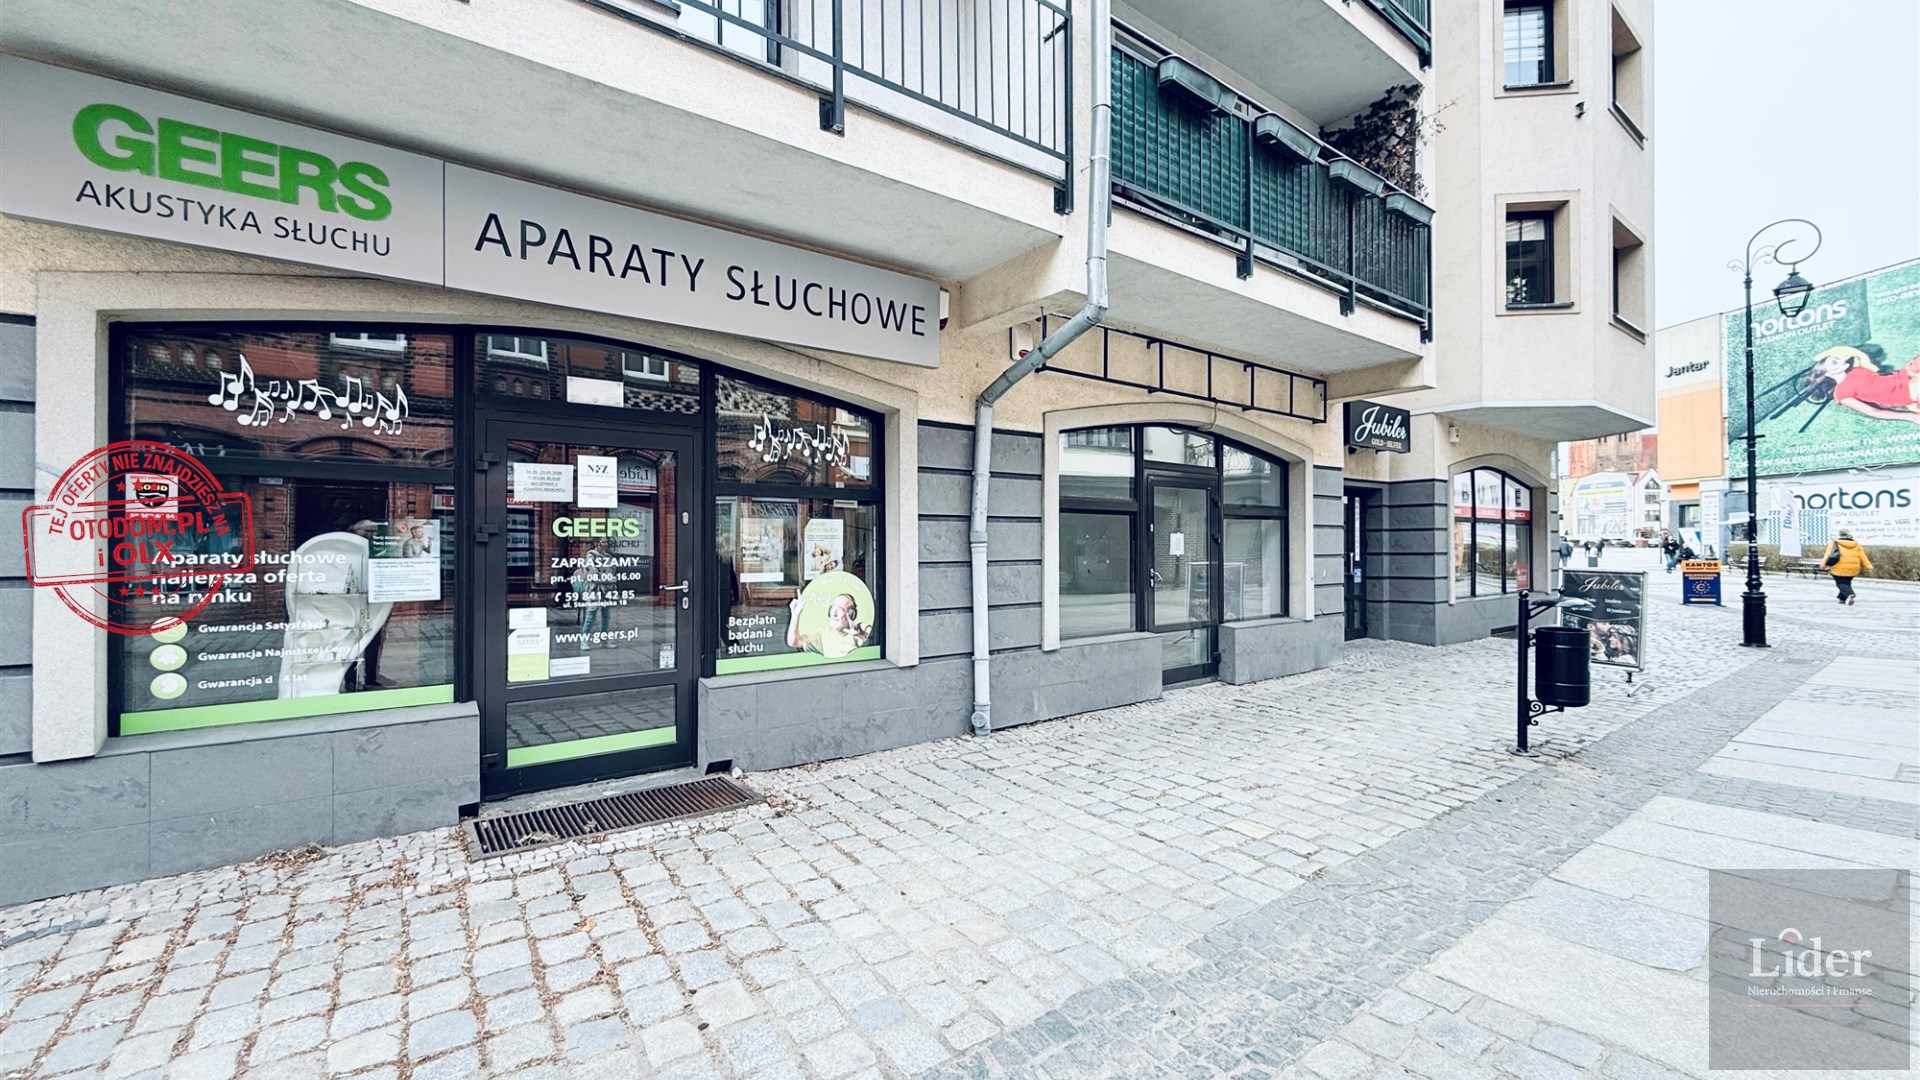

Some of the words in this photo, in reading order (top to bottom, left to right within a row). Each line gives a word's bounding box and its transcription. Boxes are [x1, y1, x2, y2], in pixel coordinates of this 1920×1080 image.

[72, 103, 392, 222] GEERS
[76, 180, 262, 235] AKUSTYKA
[274, 216, 391, 256] SŁUCHU
[475, 213, 704, 293] APARATY
[725, 264, 926, 337] SŁUCHOWE
[1755, 328, 1797, 346] FASHION
[1797, 320, 1836, 335] OUTLET
[1665, 359, 1710, 378] Jantar
[1354, 406, 1407, 442] Jubiler
[1863, 437, 1879, 446] na
[587, 464, 610, 474] NFZ
[552, 517, 640, 537] GEERS
[151, 550, 244, 568] Aparaty
[250, 550, 346, 565] słuchowe
[551, 557, 639, 568] ZAPRASZAMY
[152, 569, 257, 587] najlepsza
[263, 568, 327, 584] oferta
[550, 574, 584, 585] pn.-pt.
[586, 572, 641, 582] 08.00-16.00
[152, 591, 184, 605] na
[188, 588, 252, 606] rynku
[565, 592, 579, 602] 59
[581, 591, 601, 602] 841
[605, 590, 619, 600] 42
[621, 590, 635, 600] 85
[198, 622, 262, 633] Gwarancja
[555, 627, 639, 645] www.geers.pl
[728, 628, 773, 641] badania
[197, 650, 262, 661] Gwarancja
[728, 642, 764, 655] słuchu
[197, 677, 262, 689] Gwarancja
